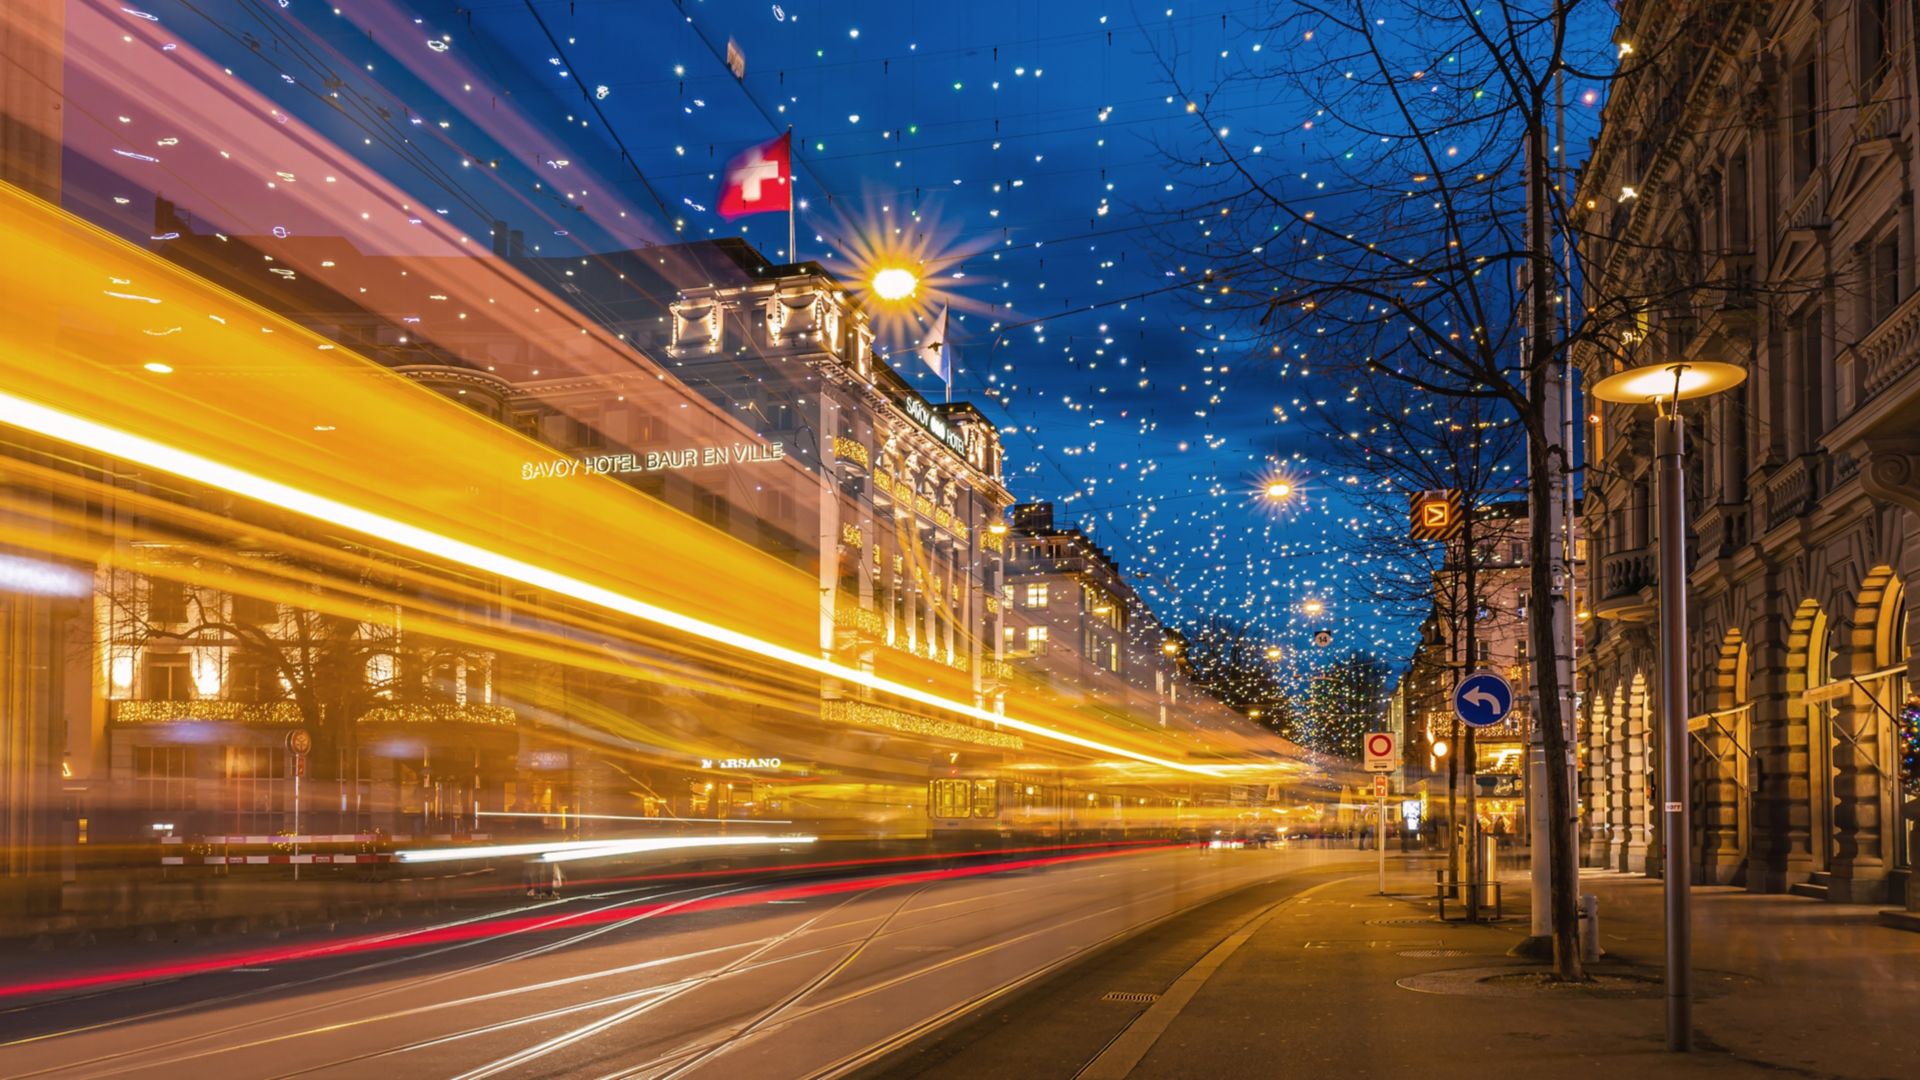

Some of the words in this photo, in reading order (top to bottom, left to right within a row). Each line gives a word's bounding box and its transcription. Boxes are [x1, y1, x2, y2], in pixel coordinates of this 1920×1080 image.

[906, 396, 929, 426] SAVOY
[946, 428, 965, 456] HOTEL
[521, 461, 579, 480] SAVOY
[584, 454, 641, 474] HOTEL
[646, 449, 697, 470] BAUR
[703, 447, 729, 466] EN
[733, 442, 784, 464] VILLE
[949, 752, 959, 764] 7
